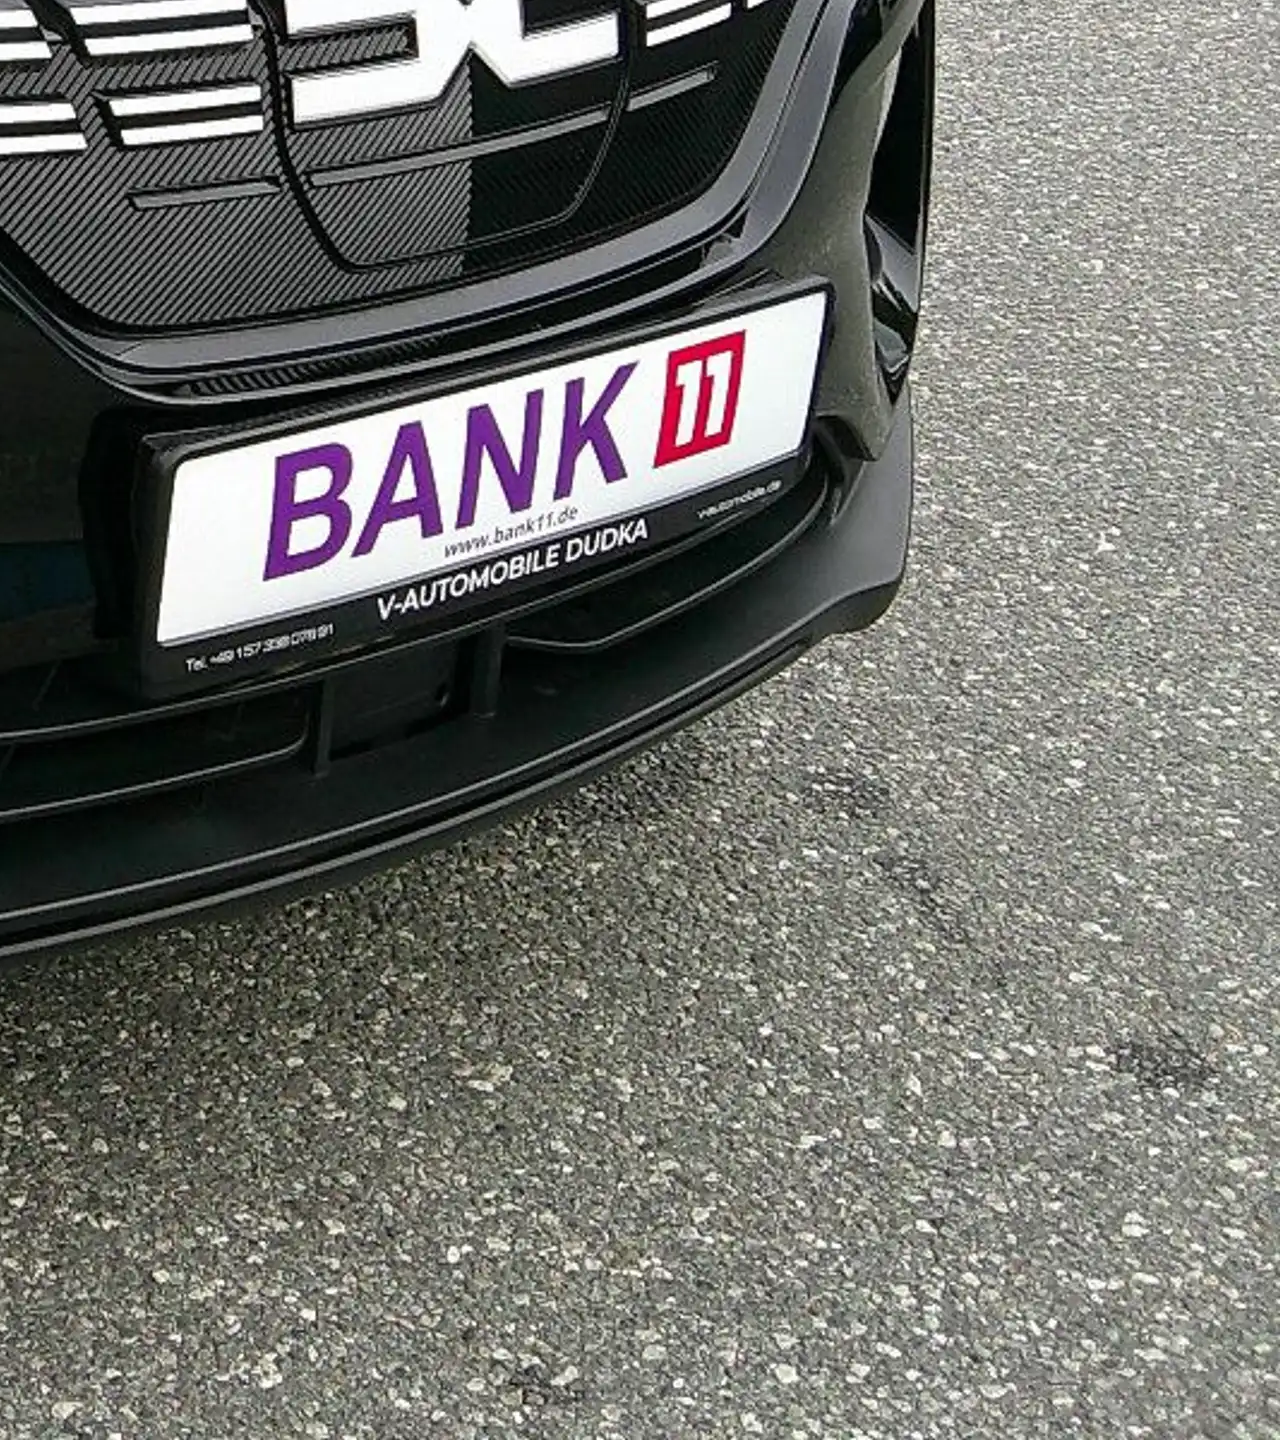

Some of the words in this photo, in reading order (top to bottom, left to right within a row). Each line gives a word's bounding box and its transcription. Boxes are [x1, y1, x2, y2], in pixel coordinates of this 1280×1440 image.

[262, 361, 640, 582] BANK
[670, 352, 740, 449] 11
[377, 543, 561, 620] V-AUTOMOBILE
[565, 518, 649, 562] DUDKA
[444, 505, 579, 558] www.bank11.de
